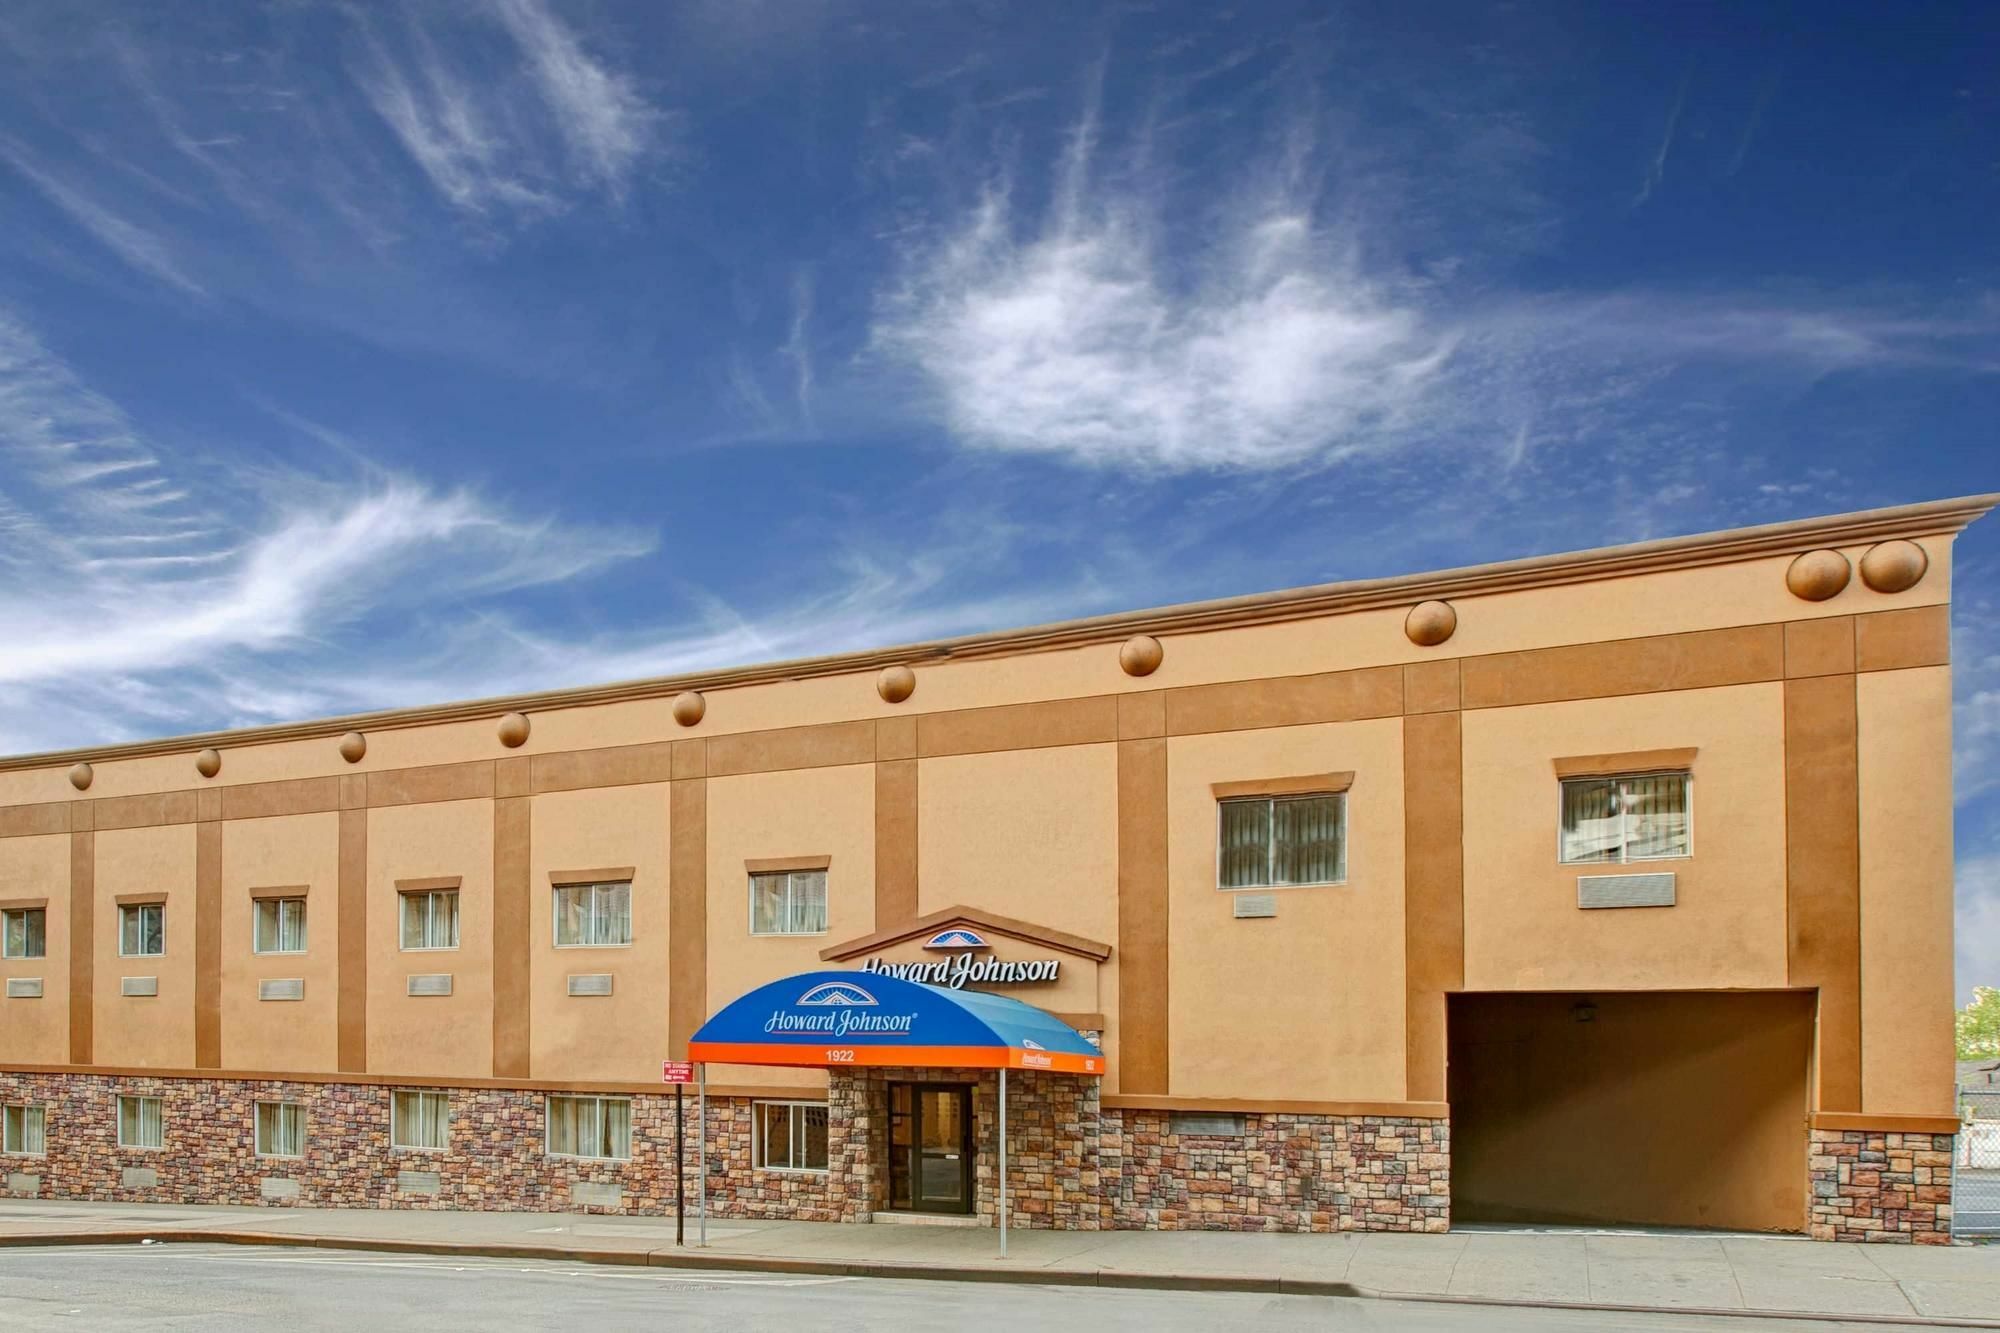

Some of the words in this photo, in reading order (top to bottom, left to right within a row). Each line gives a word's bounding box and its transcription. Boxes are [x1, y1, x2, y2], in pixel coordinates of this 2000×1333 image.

[859, 955, 952, 983] Howard
[949, 952, 1060, 990] Johnson
[764, 1010, 837, 1033] Howard
[834, 1009, 912, 1037] Johnson
[826, 1049, 855, 1062] 1922
